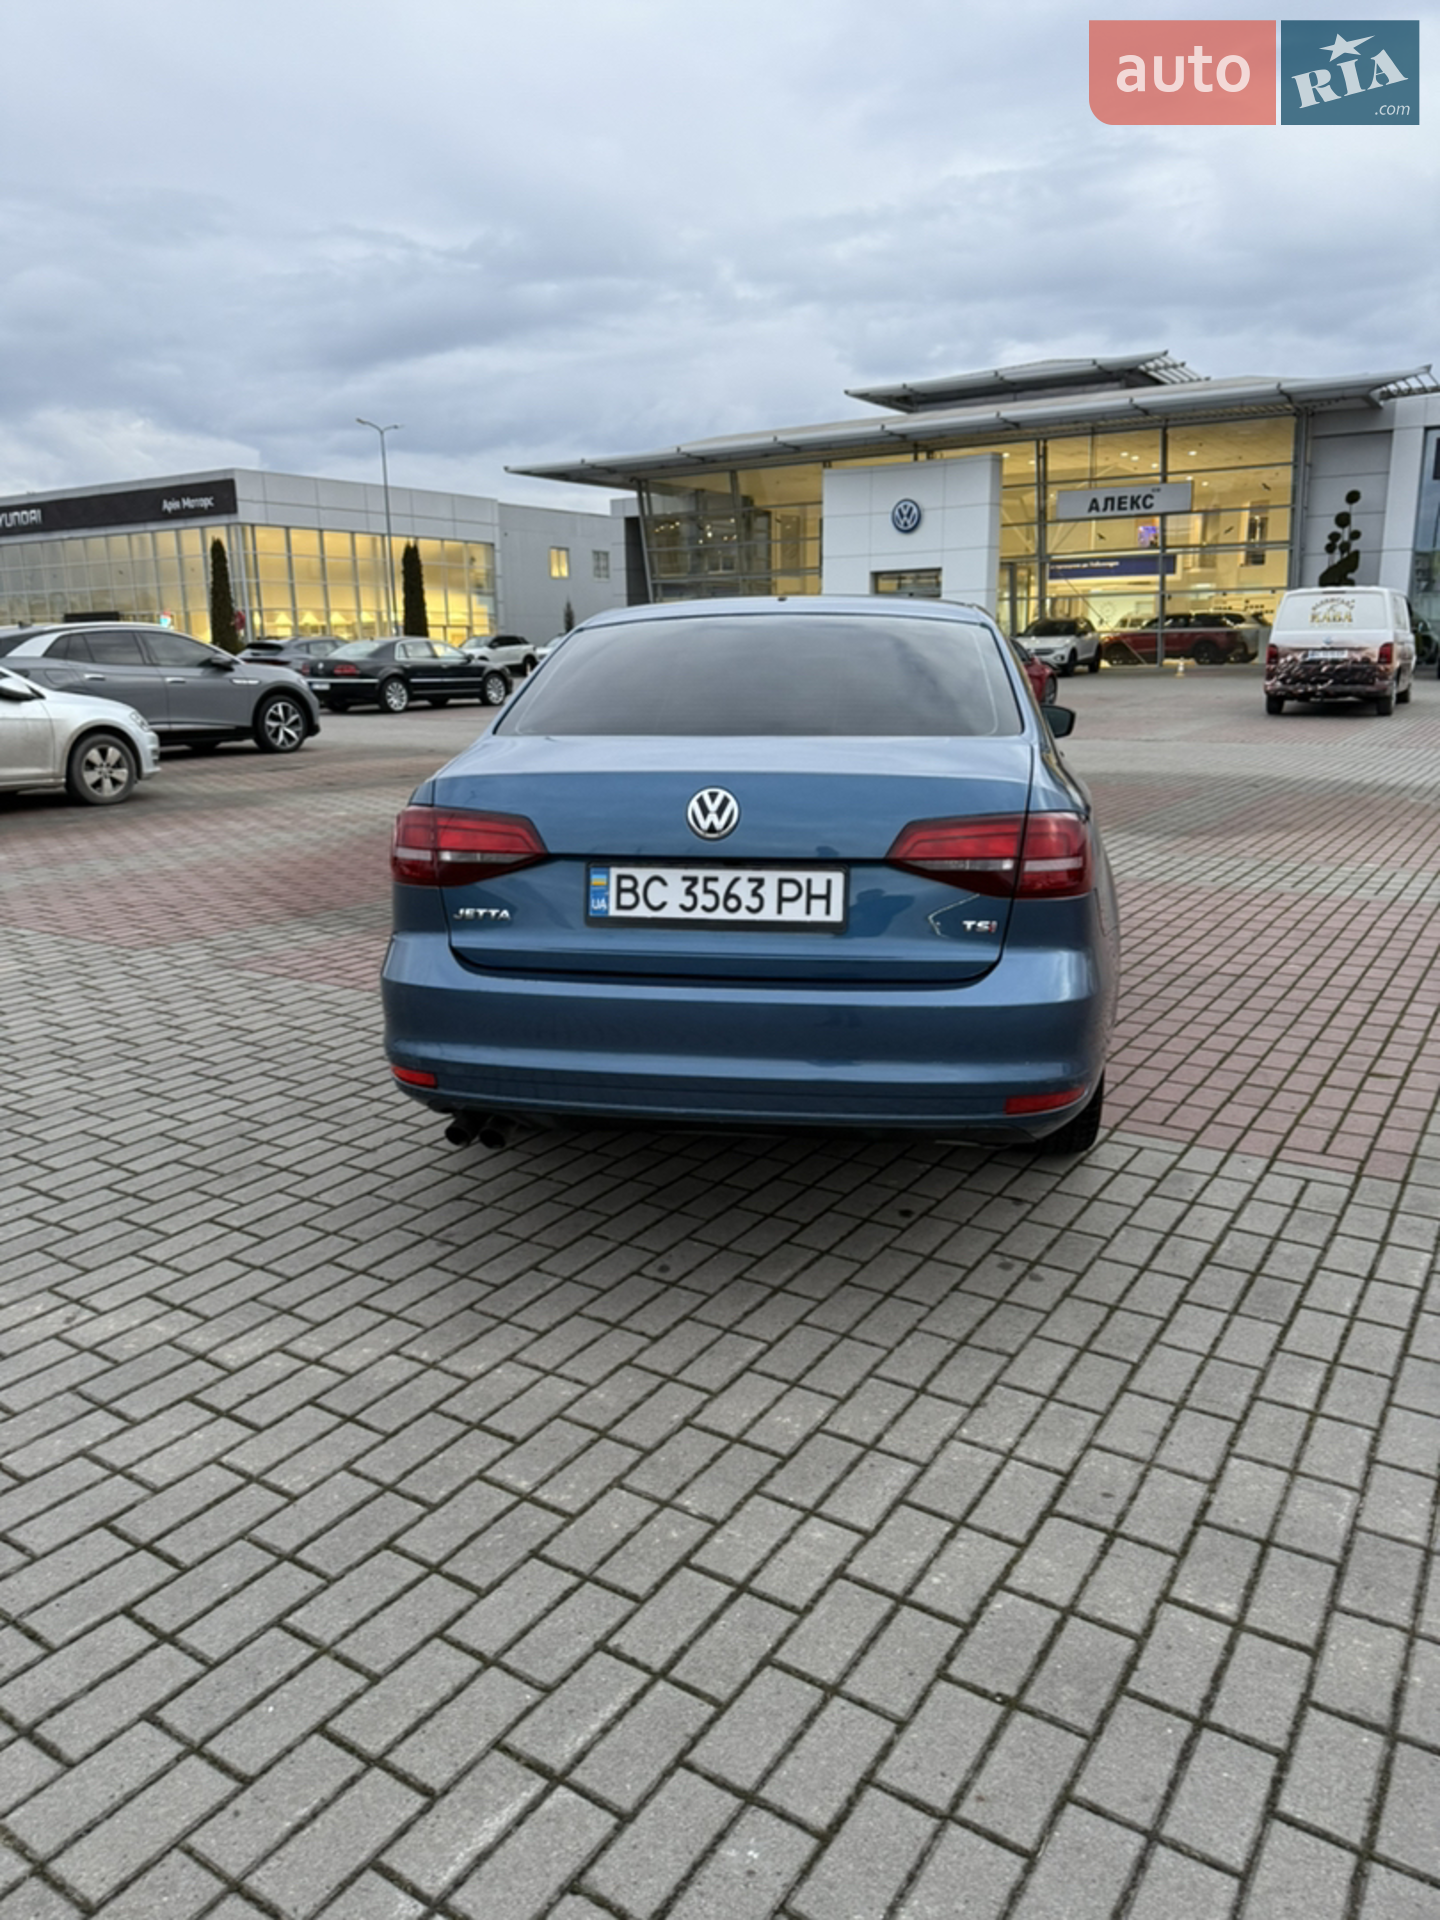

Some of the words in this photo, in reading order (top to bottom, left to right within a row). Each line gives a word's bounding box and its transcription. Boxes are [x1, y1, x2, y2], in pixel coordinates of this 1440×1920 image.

[1087, 493, 1155, 514] АЛЕКС
[615, 873, 669, 912] BC
[678, 875, 766, 914] 3563
[776, 877, 833, 916] PH
[453, 907, 512, 920] JETTA
